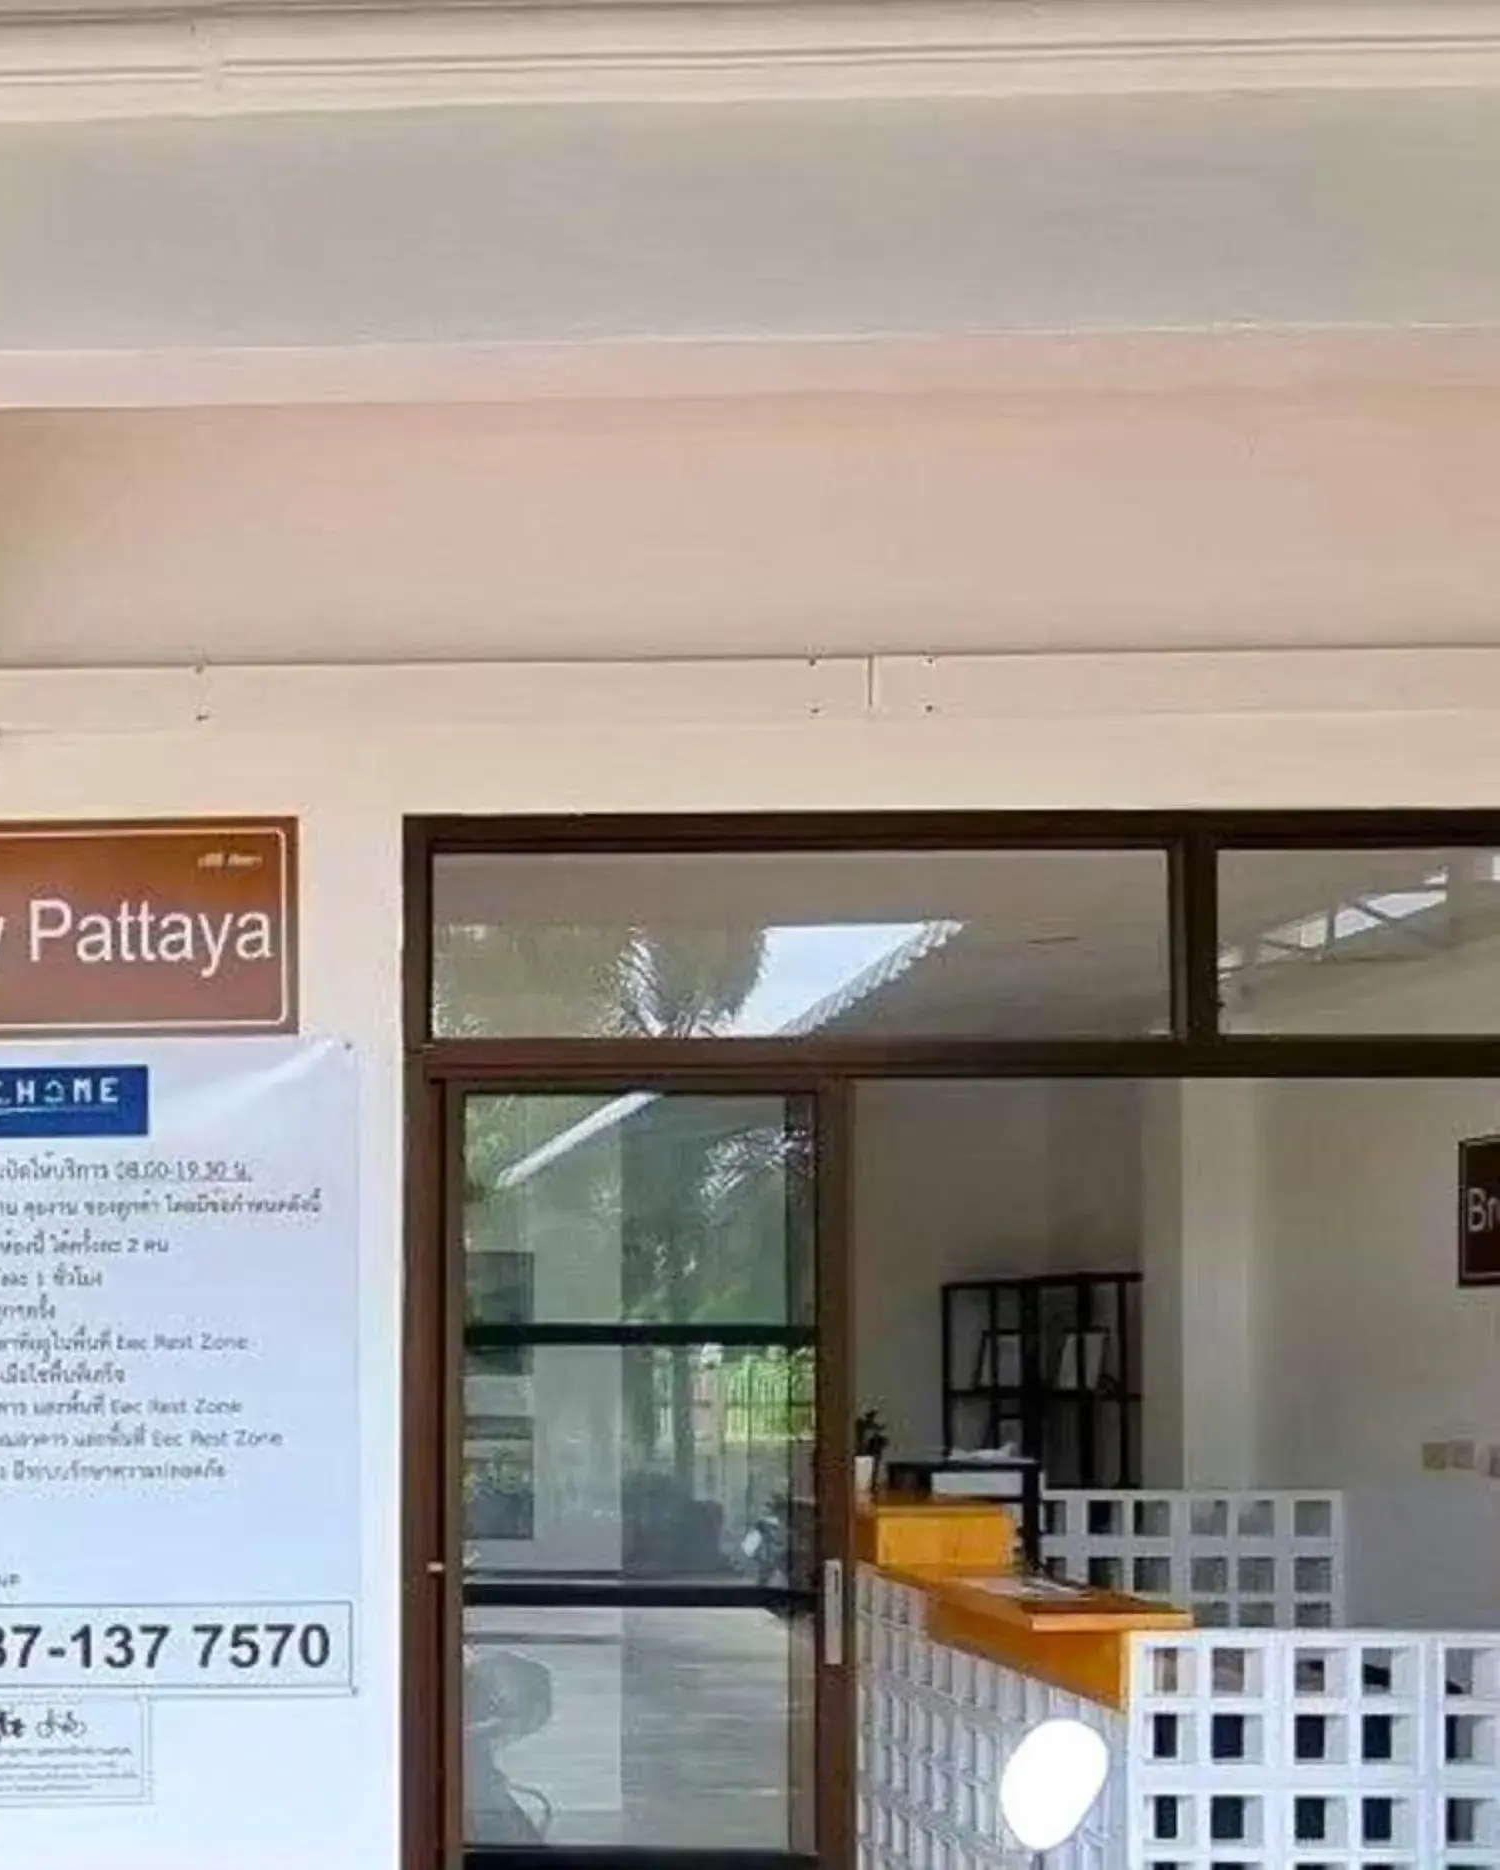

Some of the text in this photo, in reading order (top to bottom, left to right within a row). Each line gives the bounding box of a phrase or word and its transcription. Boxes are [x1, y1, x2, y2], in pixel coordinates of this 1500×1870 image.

[30, 897, 272, 978] Pattaya
[127, 1238, 140, 1253] 2
[233, 1429, 284, 1447] Zone
[192, 1622, 333, 1670] 7570
